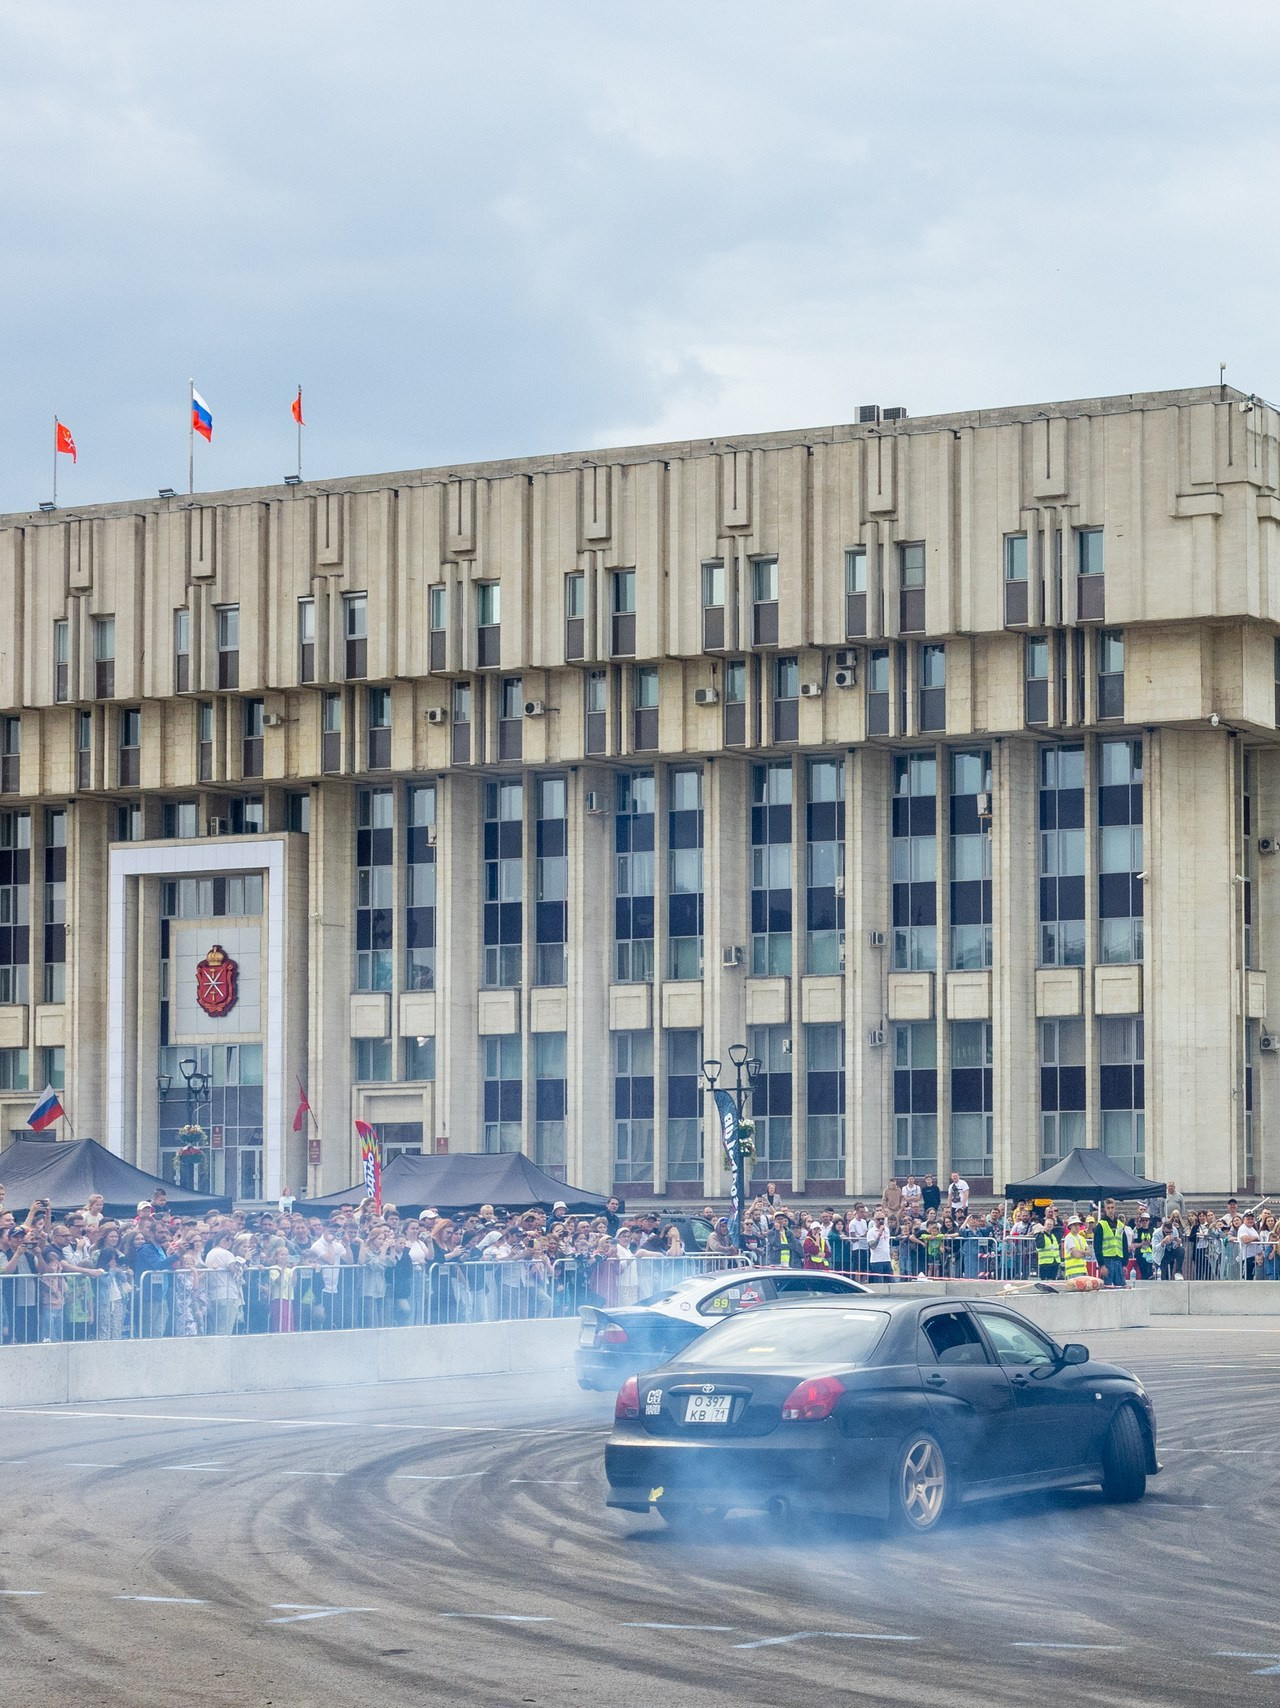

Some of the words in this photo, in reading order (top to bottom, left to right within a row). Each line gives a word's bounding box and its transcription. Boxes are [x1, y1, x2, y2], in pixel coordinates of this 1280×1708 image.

[713, 1298, 729, 1308] 69
[706, 1396, 726, 1407] 397
[690, 1410, 706, 1421] КВ
[714, 1410, 725, 1418] 71
